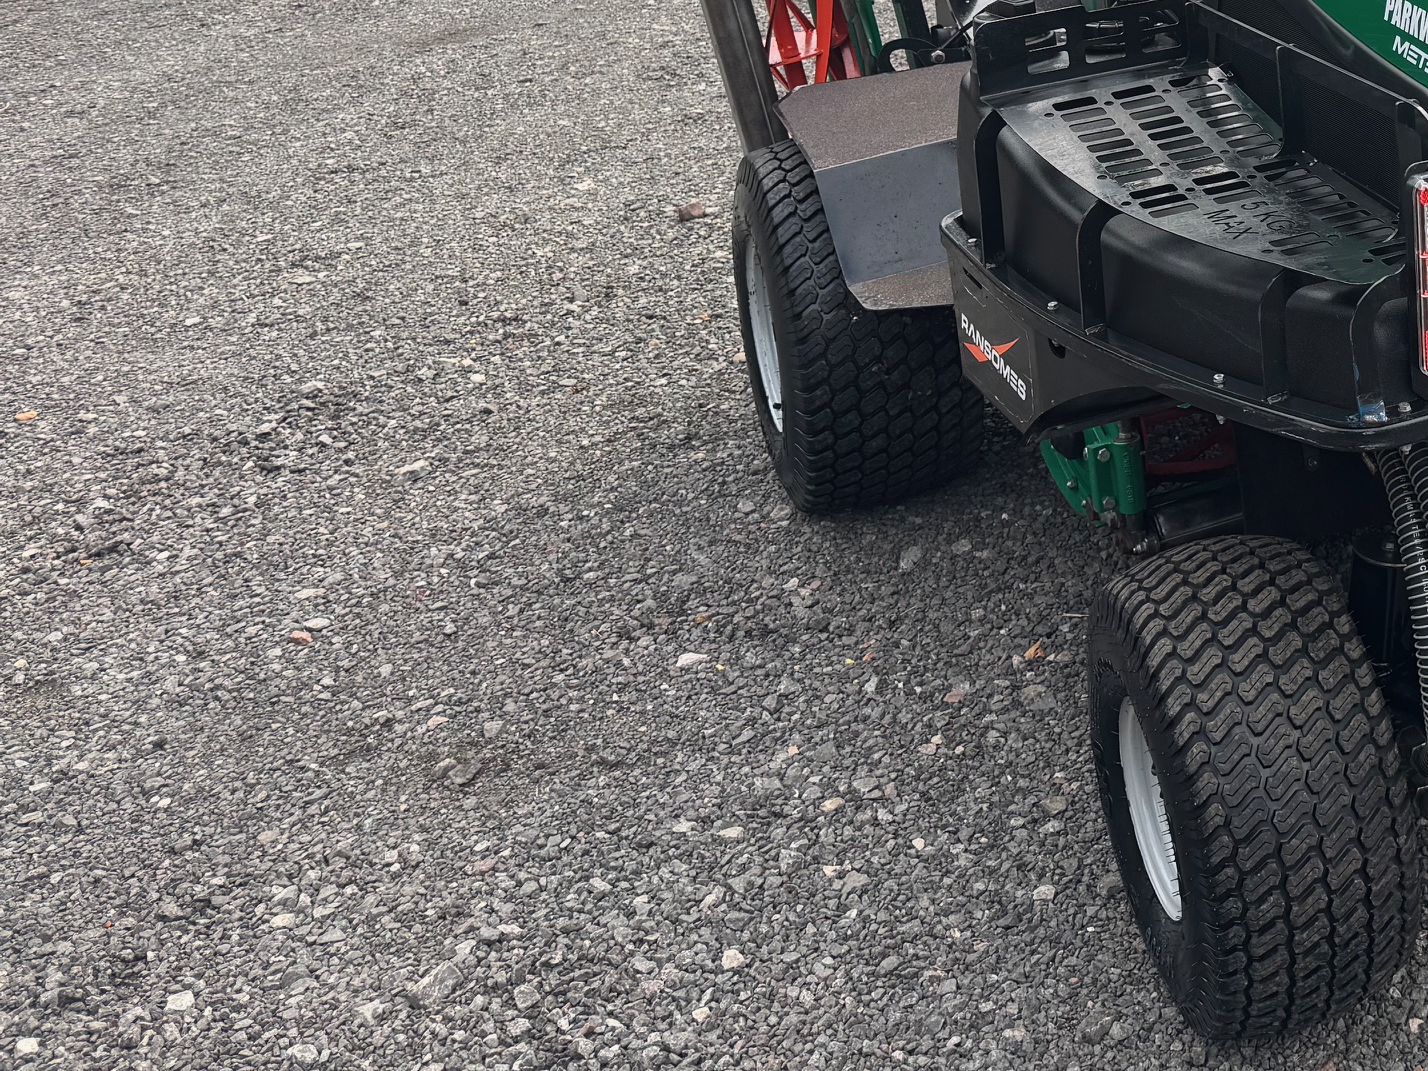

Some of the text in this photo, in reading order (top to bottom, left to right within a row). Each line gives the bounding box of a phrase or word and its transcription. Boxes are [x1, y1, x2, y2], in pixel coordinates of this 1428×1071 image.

[1203, 208, 1259, 240] MAX
[1240, 201, 1296, 231] 5 KG
[961, 313, 1027, 401] RANSOMES
